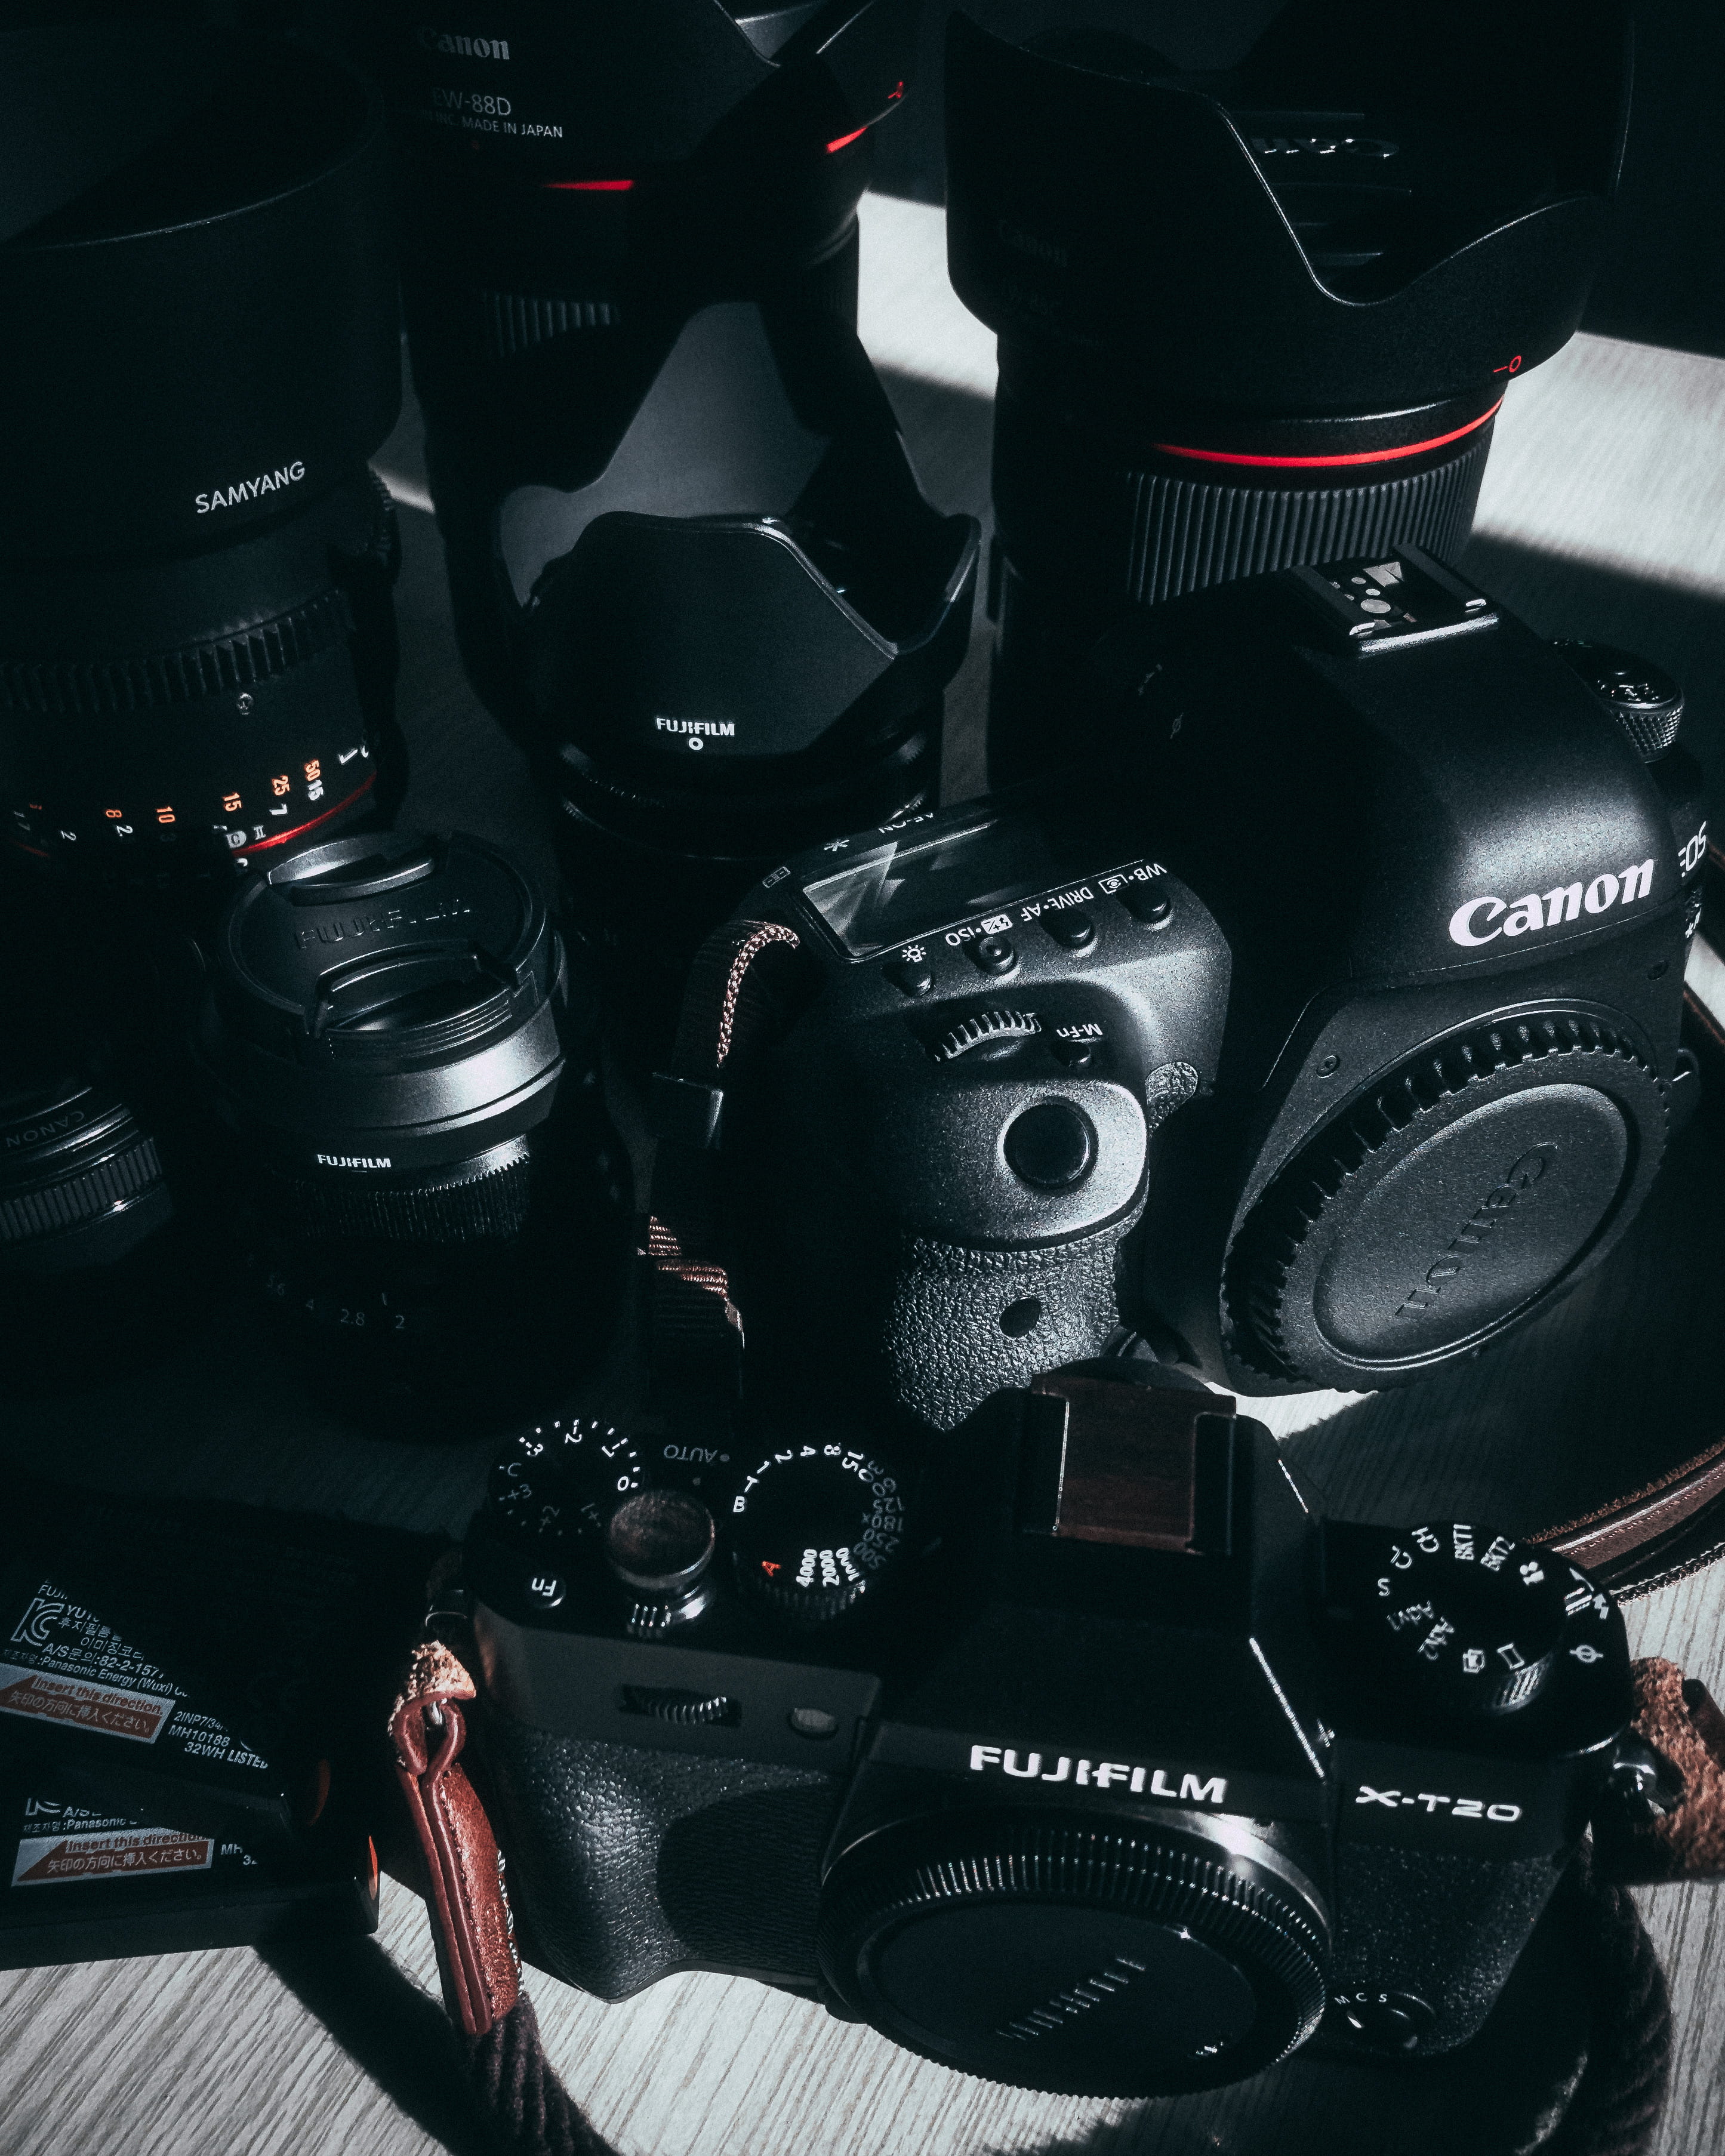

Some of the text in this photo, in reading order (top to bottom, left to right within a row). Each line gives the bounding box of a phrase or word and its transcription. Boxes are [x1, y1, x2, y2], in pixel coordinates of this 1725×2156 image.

[462, 116, 500, 133] MADE
[504, 122, 518, 135] IN
[521, 124, 563, 138] JAPAN
[195, 461, 305, 513] SAMYANG
[656, 718, 735, 736] FUJIFILM
[155, 805, 177, 824] 10
[221, 791, 243, 812] 15
[272, 774, 291, 797] 25
[303, 757, 322, 782] 50
[1449, 859, 1655, 947] Canon
[1056, 1022, 1103, 1039] M-Fn
[6, 1111, 85, 1147] CANON
[317, 1154, 392, 1169] FUJIFILM
[1396, 1141, 1558, 1316] Canon
[340, 1308, 365, 1326] 2.8
[664, 1444, 717, 1464] AUTO
[774, 1449, 793, 1464] 2
[842, 1450, 864, 1473] 15
[858, 1460, 884, 1483] 30
[872, 1477, 897, 1498] 60
[733, 1496, 746, 1513] B
[819, 1550, 840, 1588] 2000
[531, 1578, 557, 1597] Fn
[98, 1670, 137, 1688] Energy
[137, 1677, 174, 1696] (Wuxi)
[168, 1724, 231, 1747] MH10188
[184, 1742, 226, 1759] 32WH
[970, 1745, 1227, 1804] FUJIFILM
[1355, 1786, 1523, 1822] X-T20
[1356, 1992, 1367, 2002] C
[1378, 1994, 1388, 2003] S
